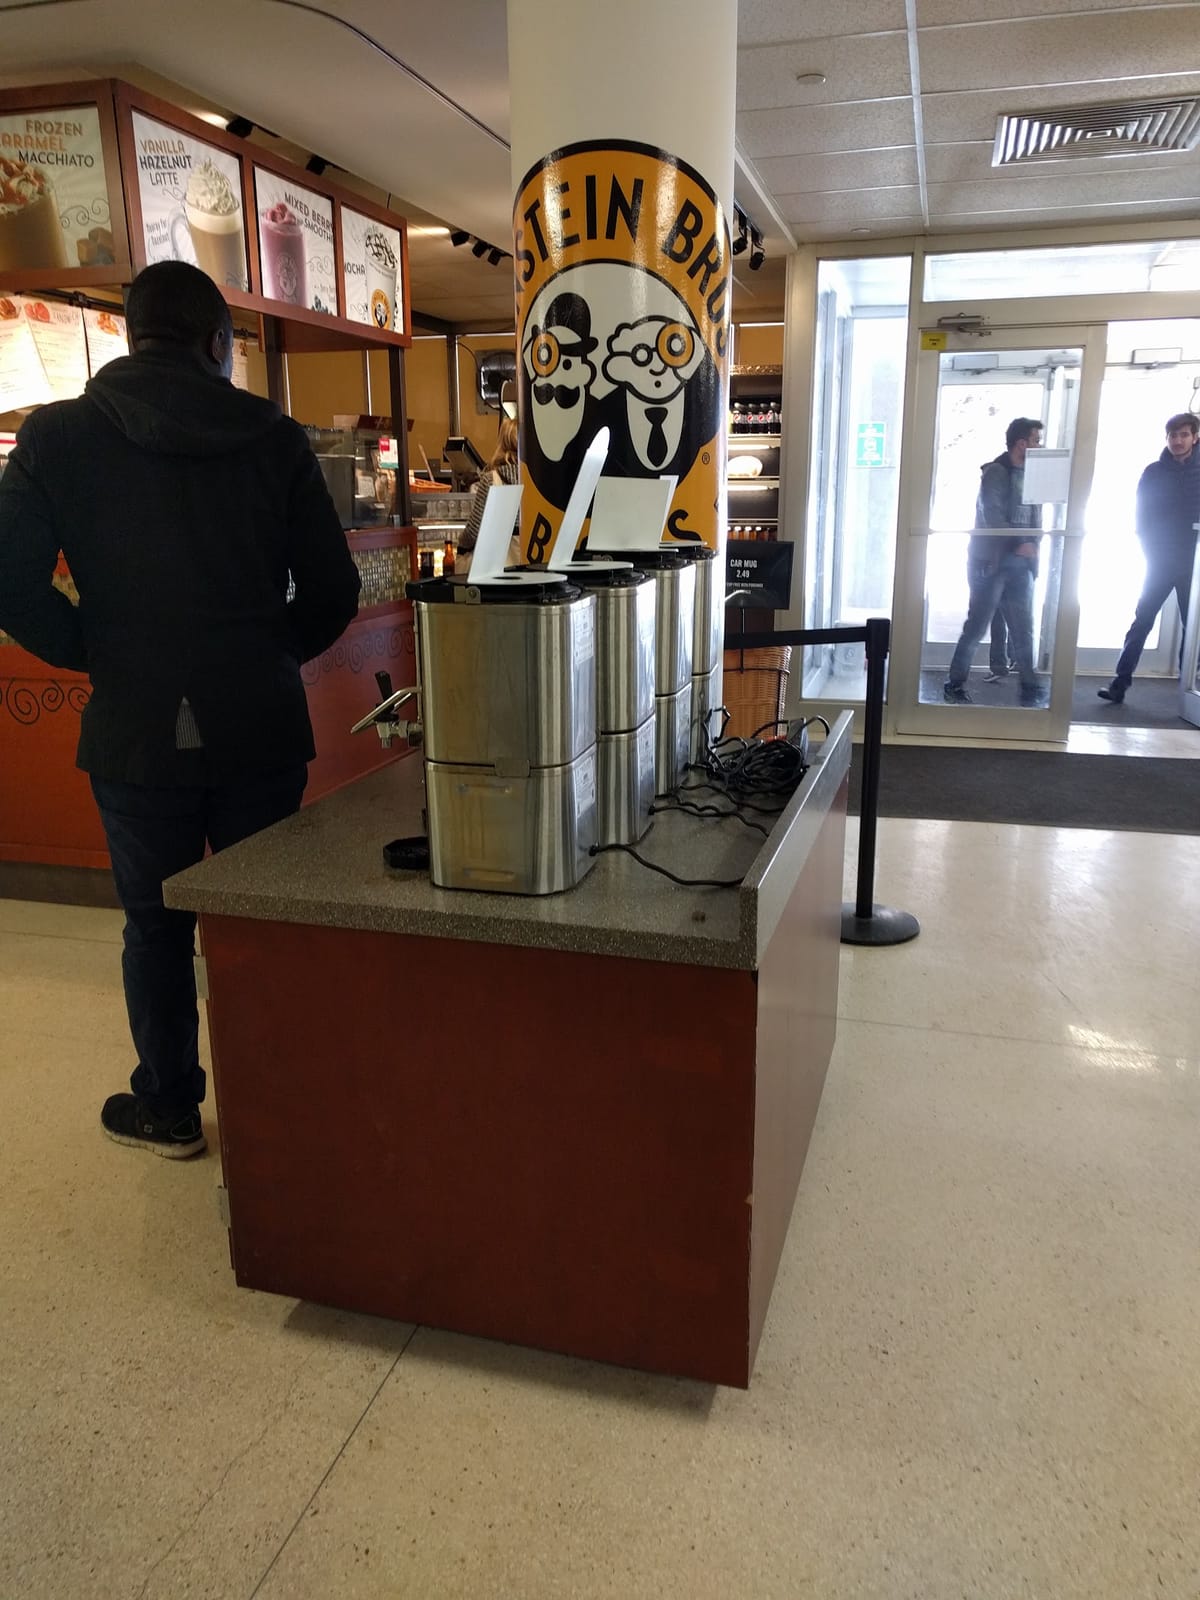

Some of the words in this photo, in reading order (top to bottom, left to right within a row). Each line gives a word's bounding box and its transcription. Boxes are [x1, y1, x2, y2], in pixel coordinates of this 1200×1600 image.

[26, 119, 84, 136] FROZEN
[0, 132, 66, 152] ARAMEL
[140, 138, 186, 154] VANILLA
[18, 150, 95, 168] MACCHIATO
[139, 155, 192, 170] HAZELNUT
[149, 171, 180, 186] LATTE
[284, 191, 310, 217] MIXED
[514, 173, 644, 290] STEIN
[344, 261, 366, 276] OCHA
[730, 558, 743, 568] CAR
[744, 559, 758, 569] MUG
